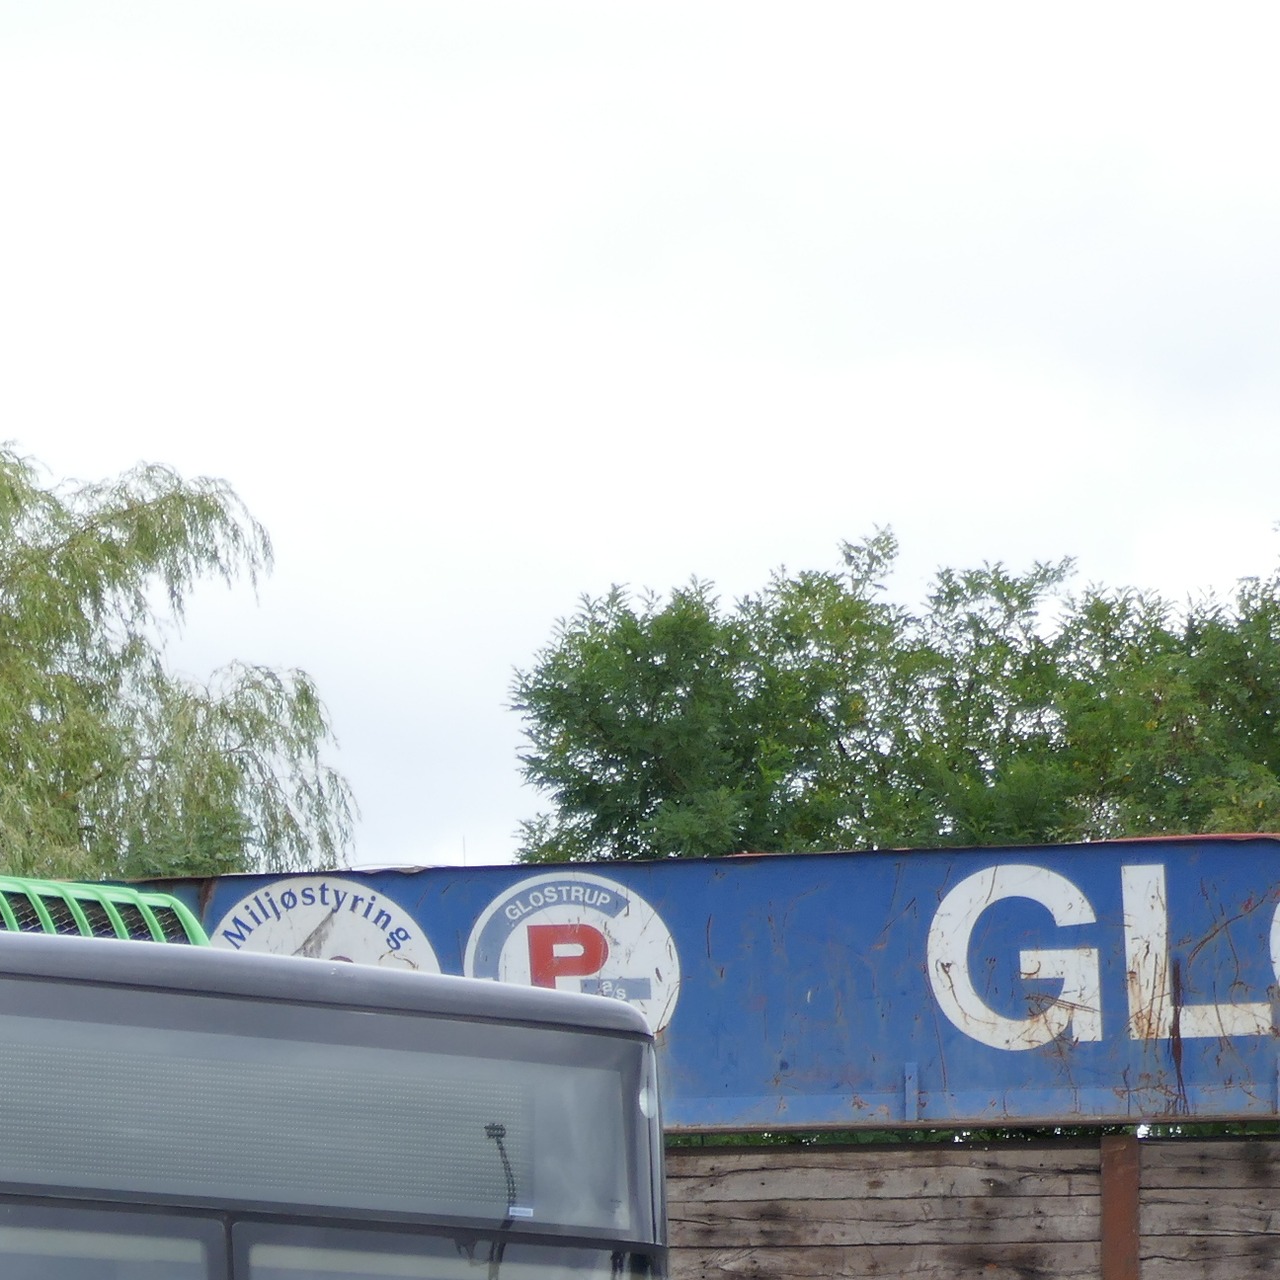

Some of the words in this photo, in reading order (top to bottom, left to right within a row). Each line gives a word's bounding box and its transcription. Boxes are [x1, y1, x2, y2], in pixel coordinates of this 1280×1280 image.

[222, 882, 412, 951] Miljøstyring
[504, 885, 611, 921] GLOSTRUP
[527, 923, 609, 990] P
[927, 863, 1280, 1051] GL
